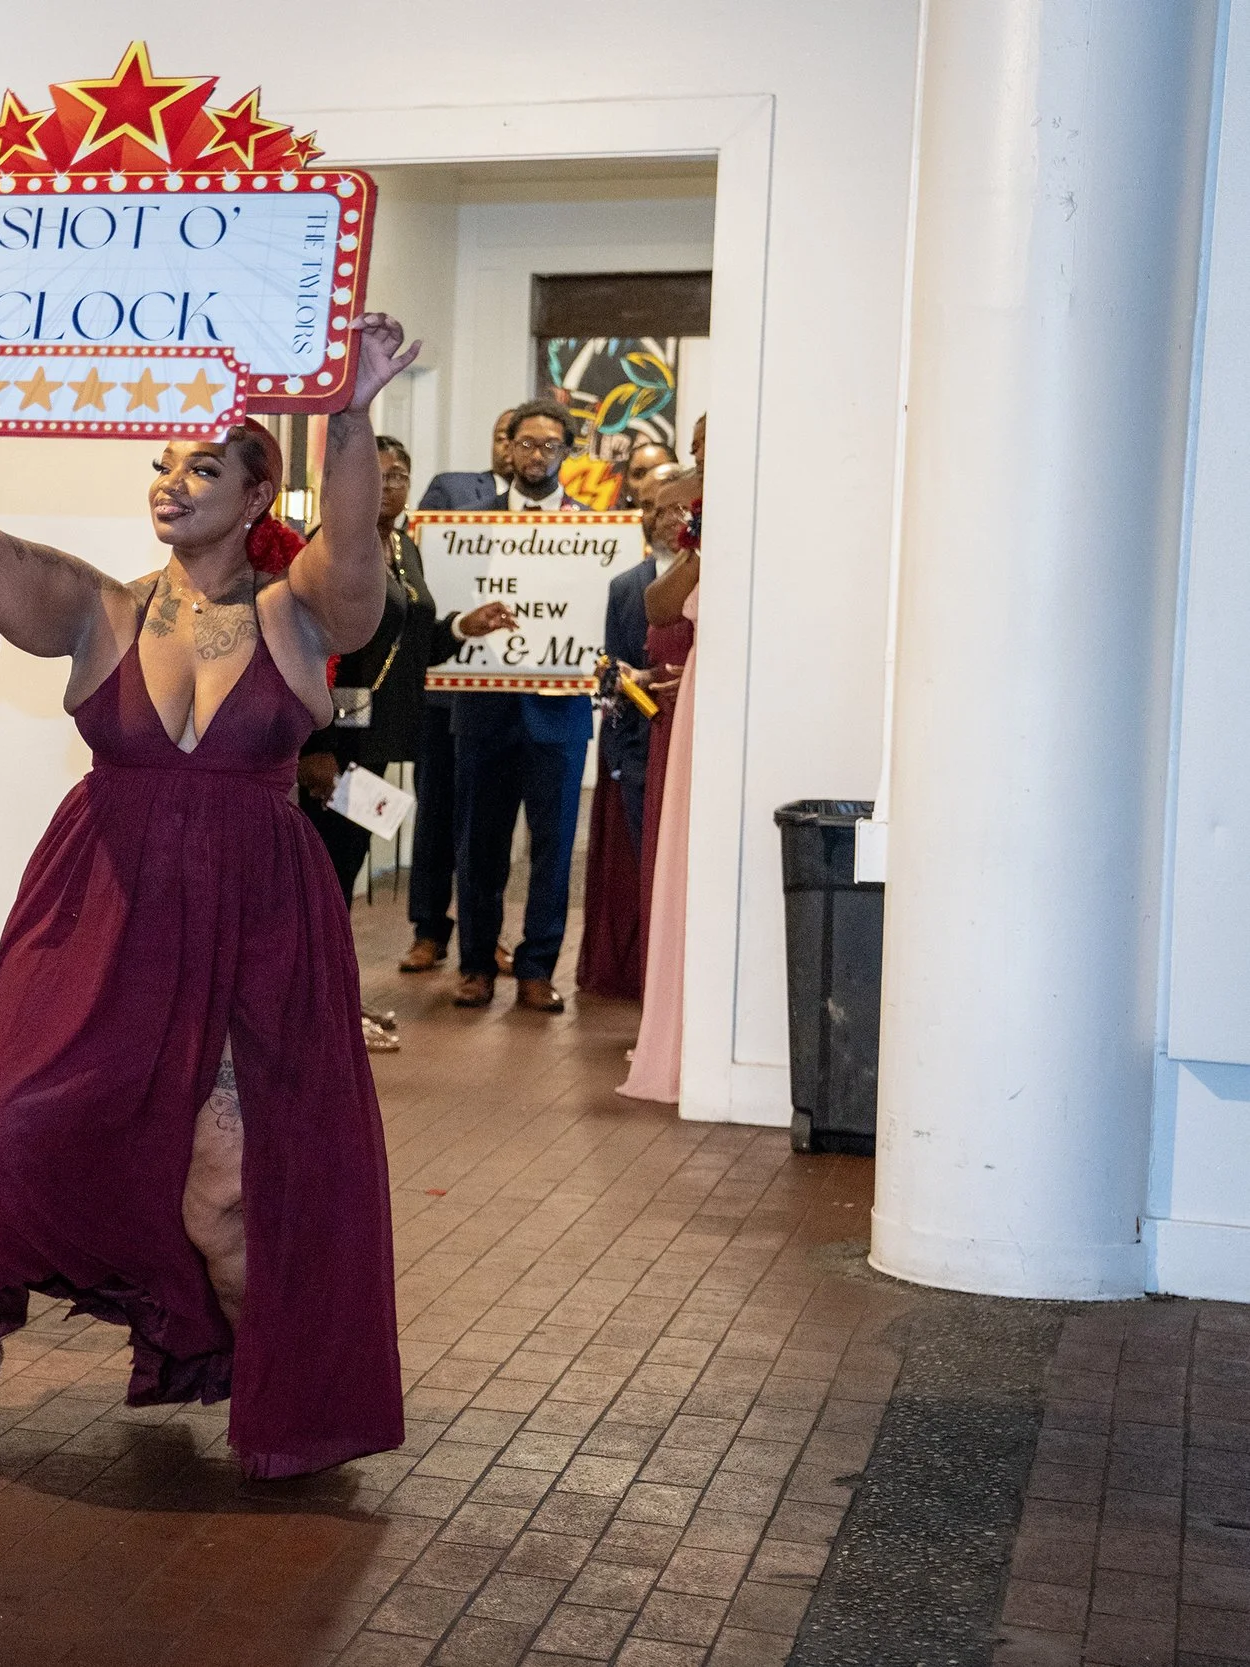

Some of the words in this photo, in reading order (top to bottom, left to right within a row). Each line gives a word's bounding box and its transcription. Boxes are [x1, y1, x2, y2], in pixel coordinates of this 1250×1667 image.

[304, 210, 328, 250] THE
[292, 257, 323, 354] TAYLORS
[443, 528, 619, 568] Introducing
[475, 576, 518, 594] THE
[514, 602, 568, 619] NEW
[503, 635, 530, 666] &
